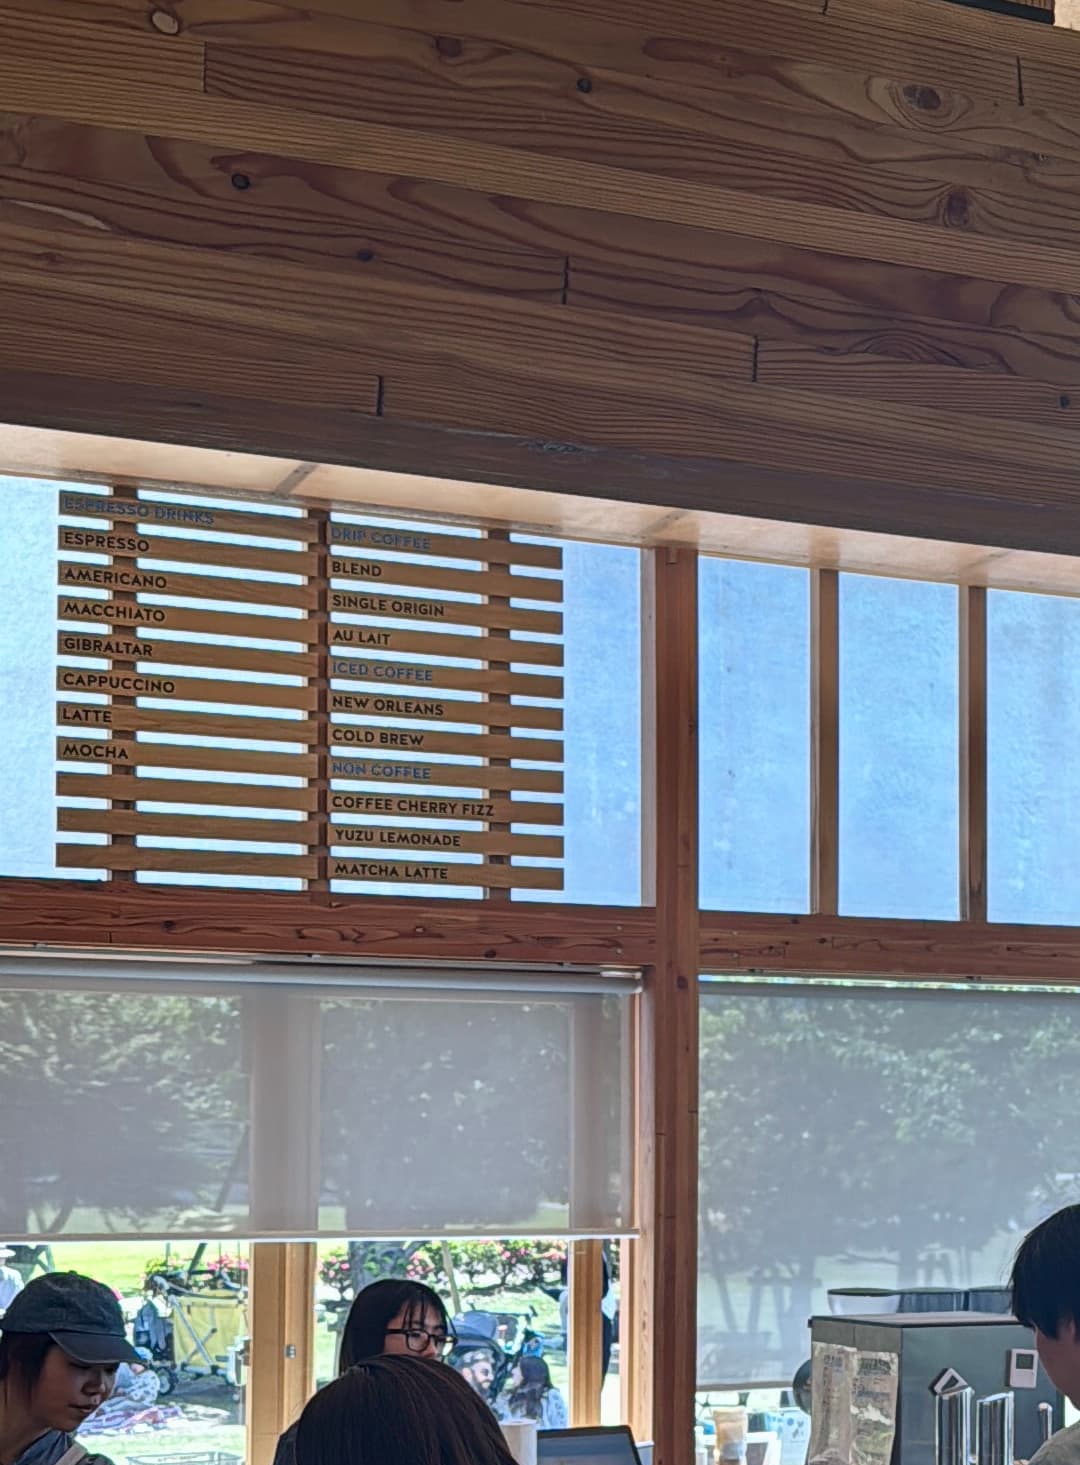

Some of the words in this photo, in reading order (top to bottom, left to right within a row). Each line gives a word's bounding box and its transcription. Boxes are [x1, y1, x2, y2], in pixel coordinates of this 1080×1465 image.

[64, 500, 149, 517] ESPRESSO
[154, 508, 214, 525] DRINKS
[64, 532, 150, 552] ESPRESSO
[331, 527, 365, 542] DRIP
[371, 531, 431, 549] COFFEE
[332, 562, 382, 577] BLEND
[64, 570, 167, 589] AMERICANO
[64, 602, 165, 622] MACCHIATO
[332, 595, 386, 611] SINGLE
[391, 601, 444, 616] ORIGIN
[64, 637, 153, 657] GIBRALTAR
[333, 630, 354, 642] AU
[358, 632, 391, 645] LAIT
[333, 662, 368, 675] ICED
[373, 664, 432, 681] COFFEE
[63, 672, 175, 693] CAPPUCCINO
[332, 695, 369, 709] NEW
[374, 699, 444, 716] ORLEANS
[63, 709, 112, 723] LATTE
[332, 729, 374, 743] COLD
[380, 733, 424, 746] BREW
[63, 744, 128, 760] MOCHA
[332, 762, 365, 775] NON
[371, 765, 431, 779] COFFEE
[332, 796, 392, 811] COFFEE
[397, 800, 457, 815] CHERRY
[462, 803, 494, 817] FIZZ
[335, 829, 374, 842] YUZU
[380, 832, 461, 847] LEMONADE
[334, 863, 399, 877] MATCHA
[404, 866, 448, 879] LATTE
